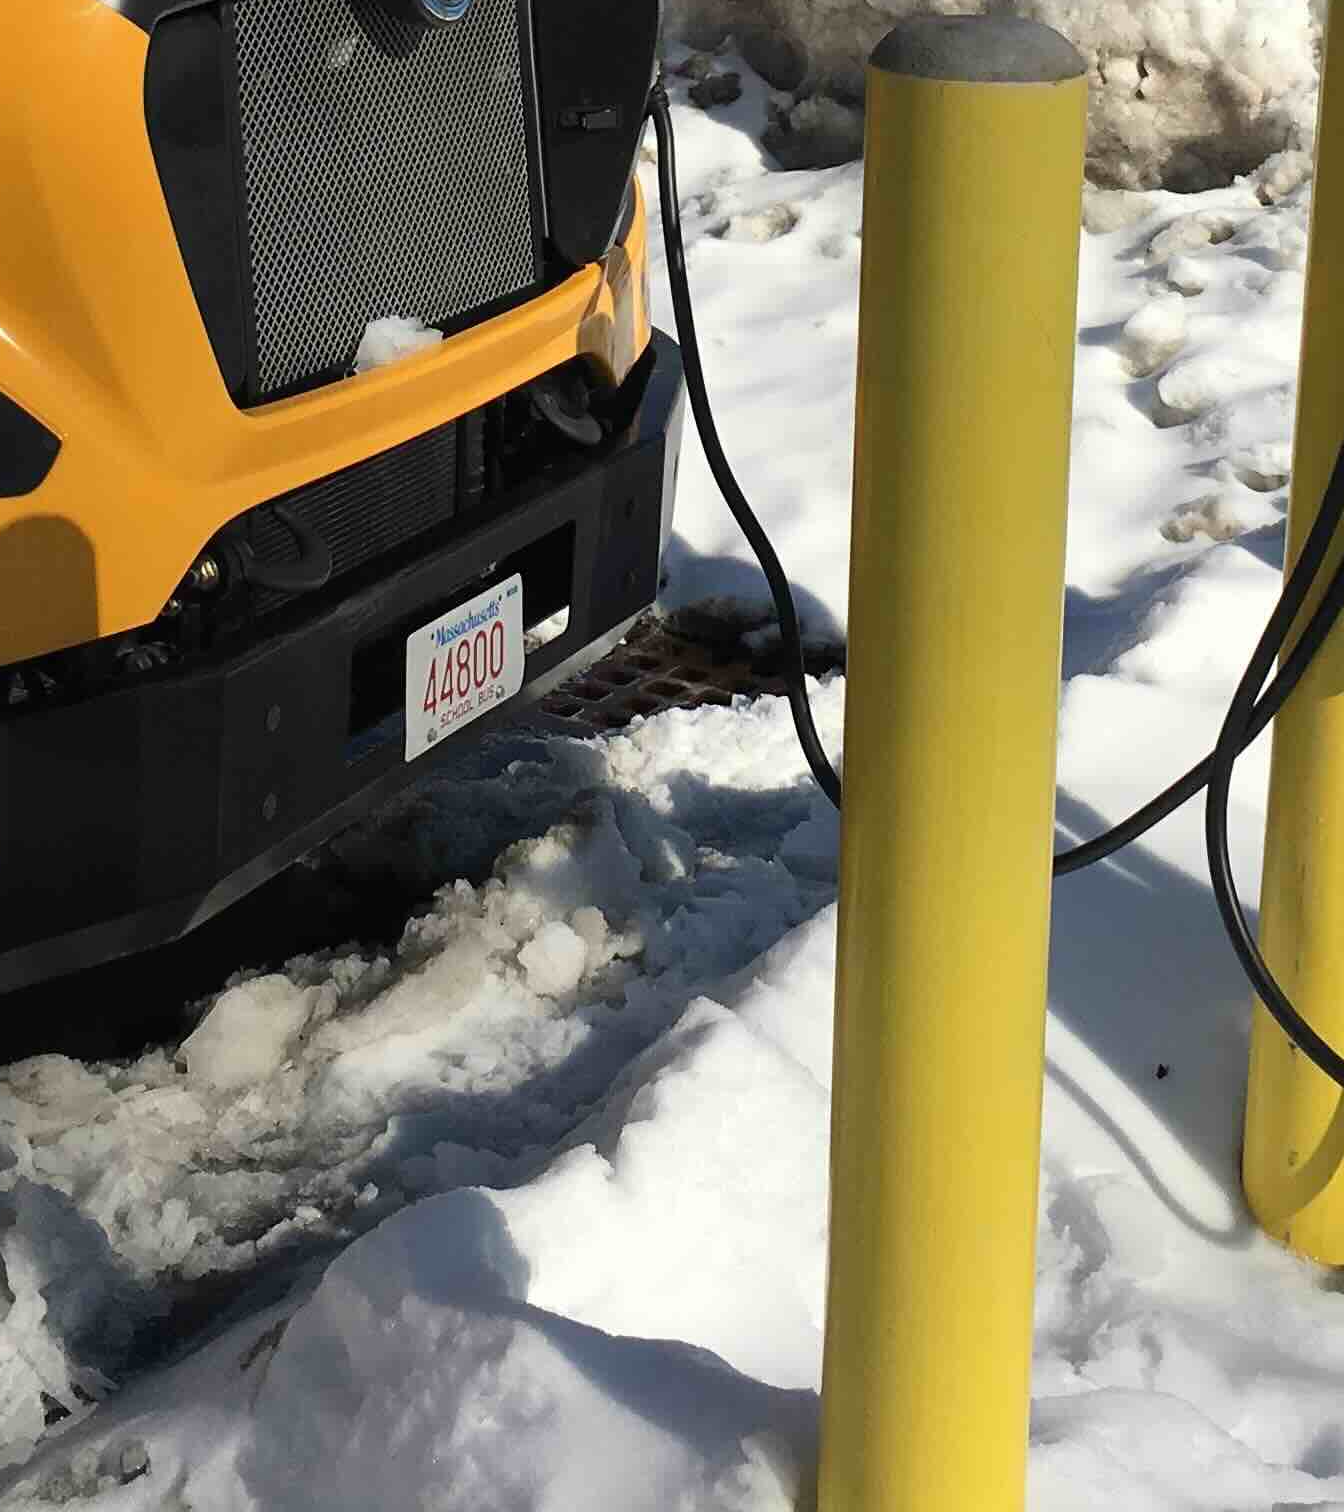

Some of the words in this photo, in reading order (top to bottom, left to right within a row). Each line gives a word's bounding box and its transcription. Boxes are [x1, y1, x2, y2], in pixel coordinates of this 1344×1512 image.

[435, 598, 502, 647] Massachusetts
[423, 620, 505, 717] 44800
[439, 699, 475, 728] SCHOOL
[478, 685, 494, 705] BUS
